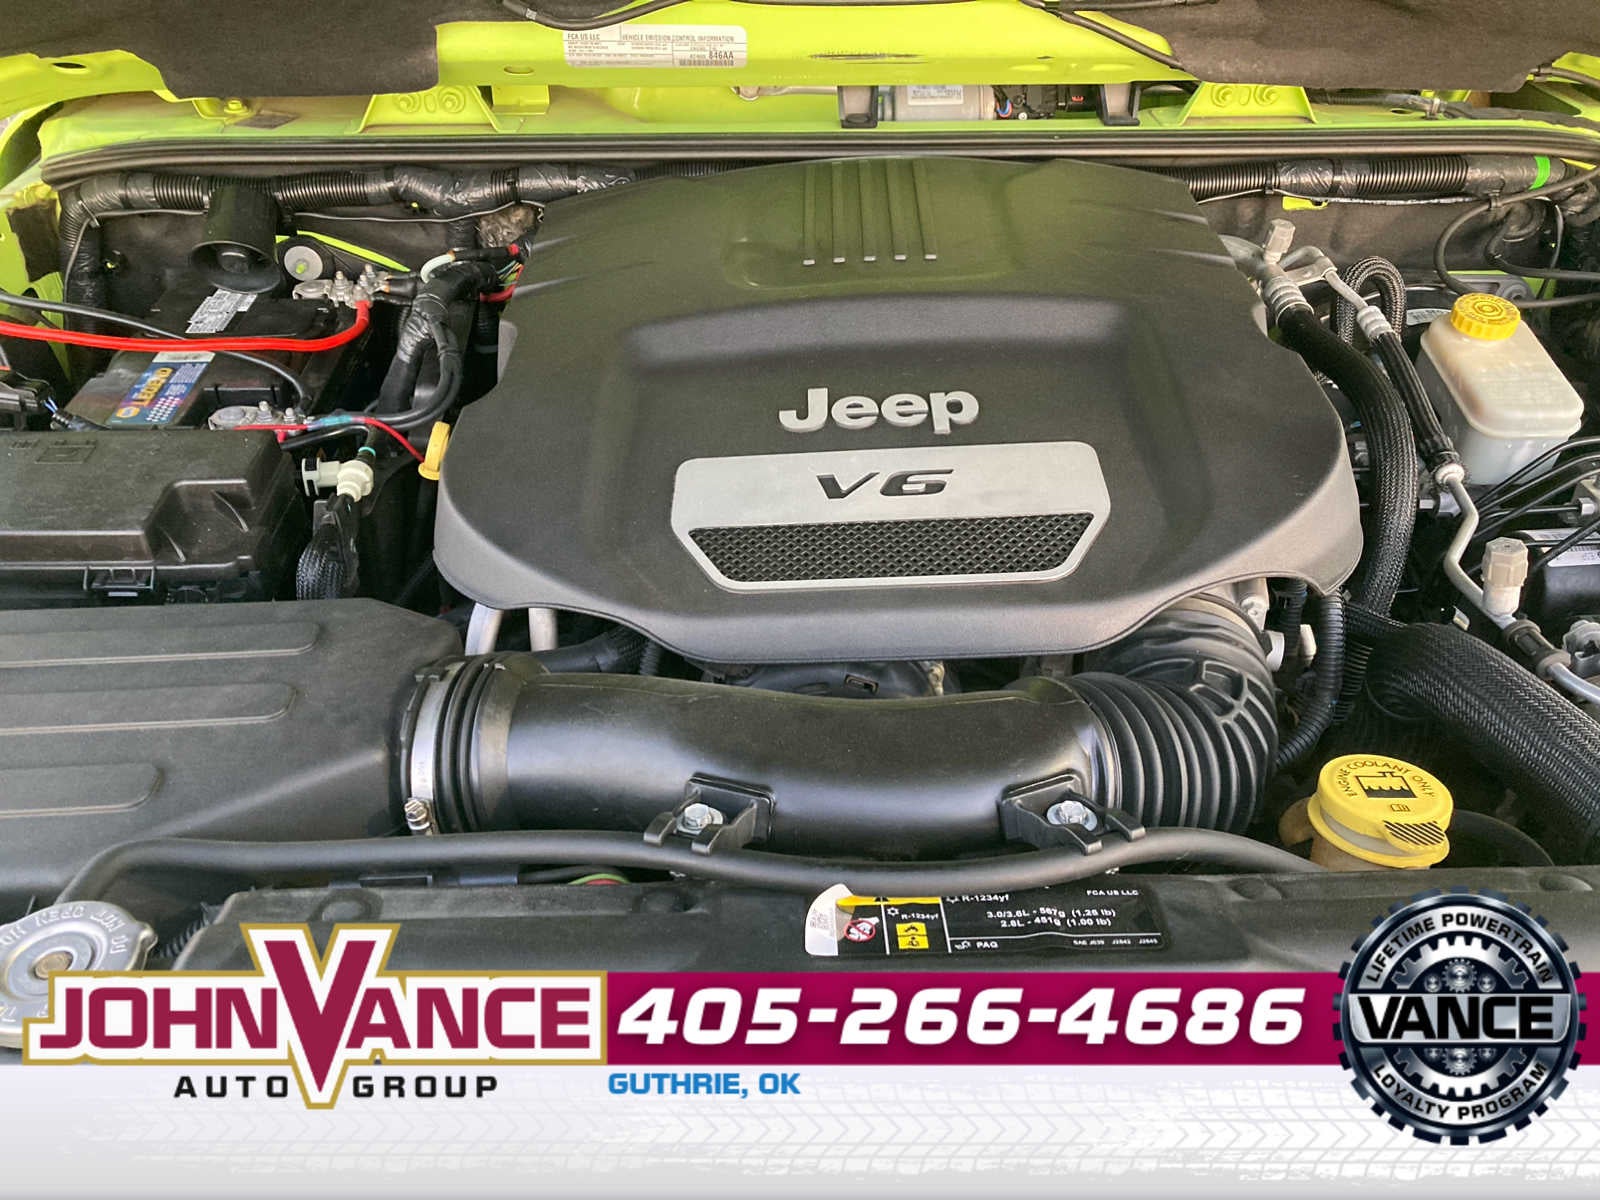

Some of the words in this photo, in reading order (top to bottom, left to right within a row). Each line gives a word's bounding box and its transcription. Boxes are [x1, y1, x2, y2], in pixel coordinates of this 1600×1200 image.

[709, 50, 734, 60] 846AA
[778, 387, 980, 434] Jeep
[816, 468, 955, 499] V6
[1346, 760, 1412, 775] COOLANT
[1336, 768, 1358, 798] ENGINE
[1412, 775, 1436, 798] ONLY
[962, 894, 1009, 904] R-1234yf
[901, 912, 939, 922] R-1234yf
[1100, 908, 1116, 918] lb)
[1094, 918, 1112, 928] lb)
